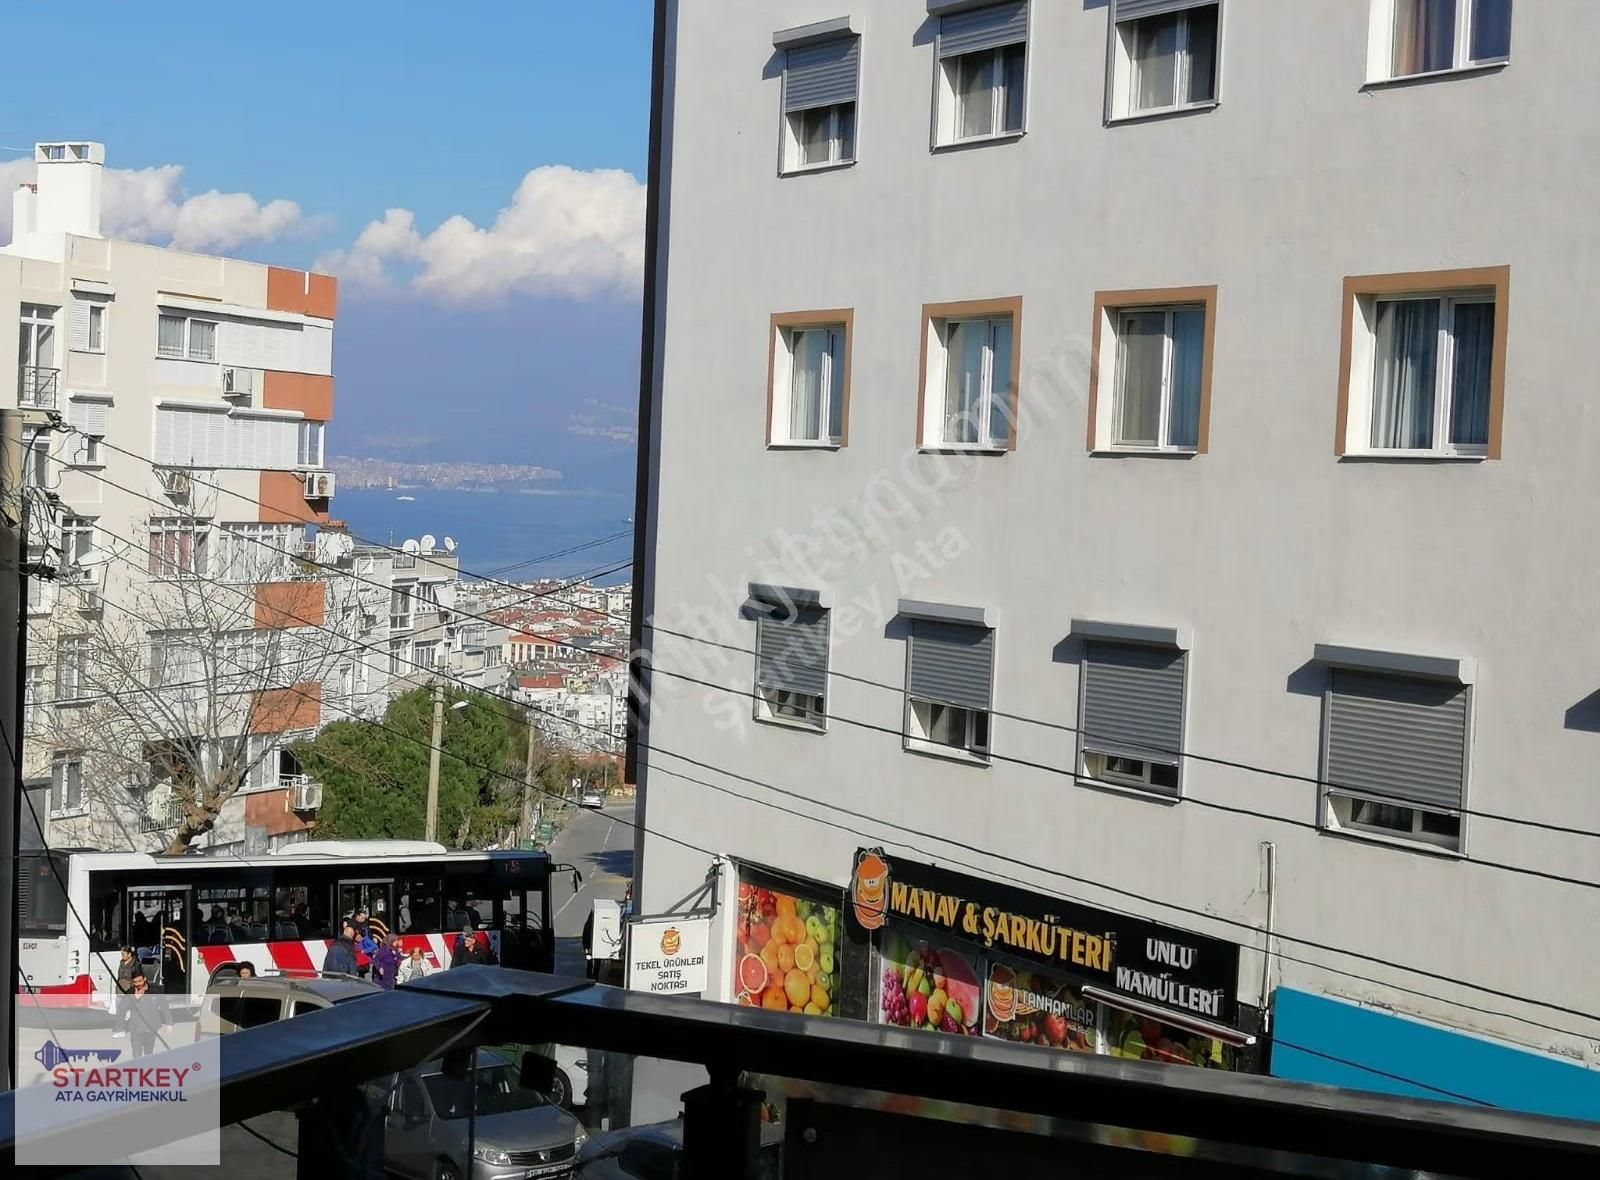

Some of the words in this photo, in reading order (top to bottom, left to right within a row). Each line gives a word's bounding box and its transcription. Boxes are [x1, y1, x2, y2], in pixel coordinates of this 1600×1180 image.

[891, 881, 961, 926] MANAV
[962, 903, 982, 935] &
[983, 907, 1115, 972] ŞARKÜTERİ
[636, 960, 661, 970] TEKEL
[663, 955, 704, 968] ÜRÜNLERİ
[1146, 937, 1194, 970] UNLU
[651, 979, 688, 991] NOKTASI
[658, 970, 681, 980] SATIŞ
[1116, 967, 1222, 1017] MAMÜLLERİ
